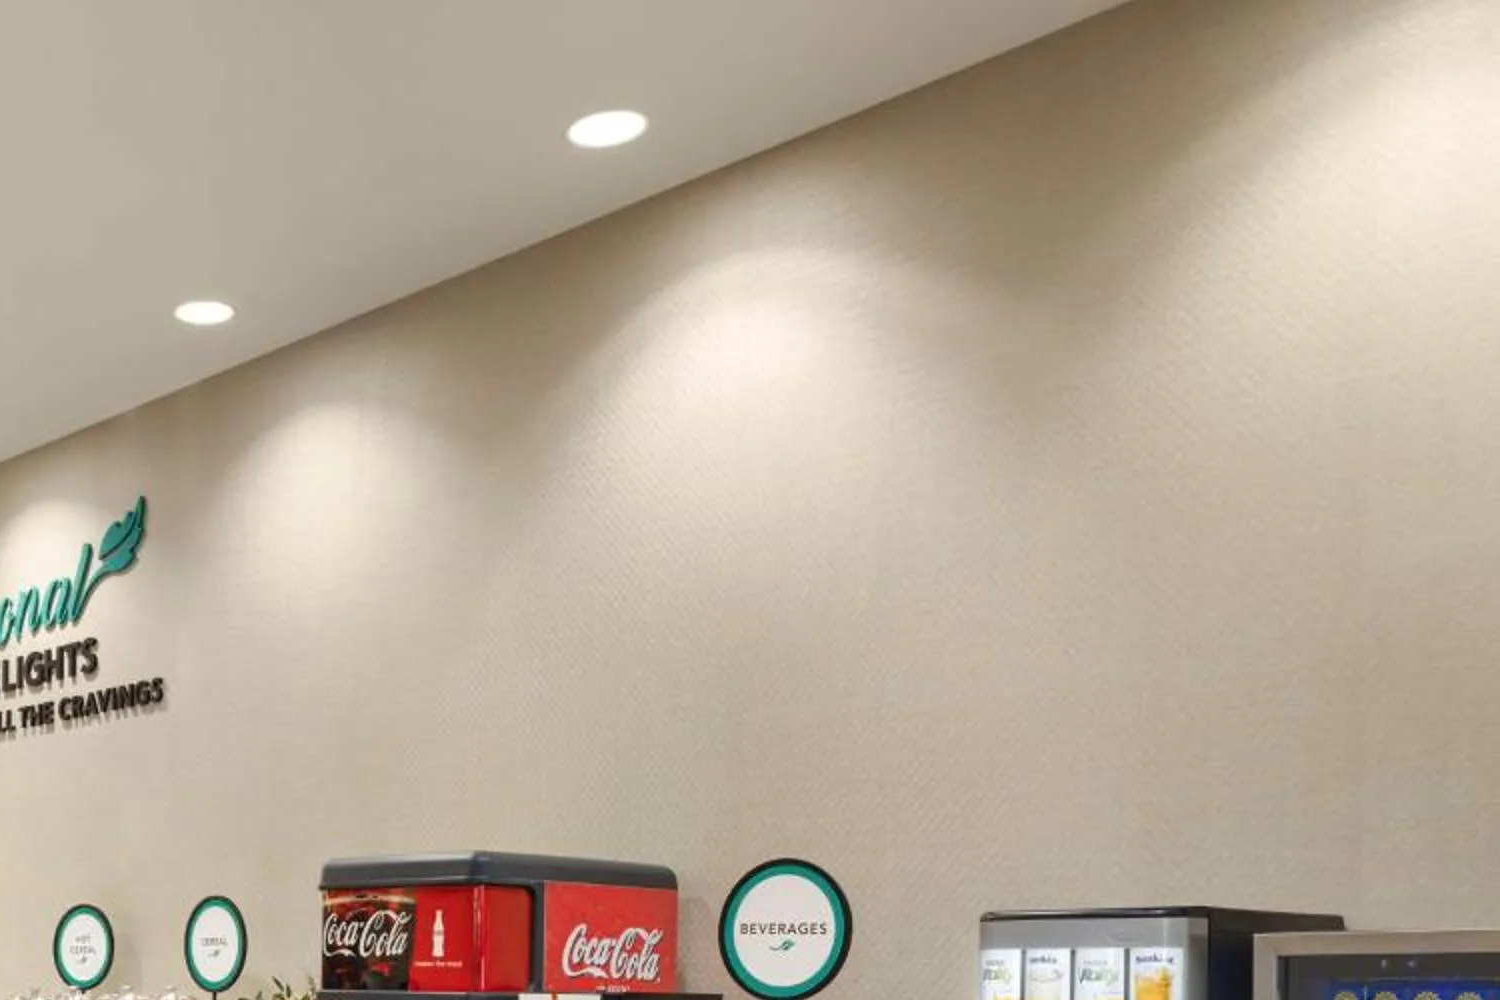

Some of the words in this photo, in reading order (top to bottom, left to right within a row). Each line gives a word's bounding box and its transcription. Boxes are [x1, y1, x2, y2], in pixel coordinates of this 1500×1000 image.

[18, 701, 55, 729] THE
[58, 677, 165, 723] CRAVINGS
[323, 909, 412, 958] Coca-Cola
[562, 923, 664, 982] Coca-Cola
[739, 922, 828, 936] BEVERAGES
